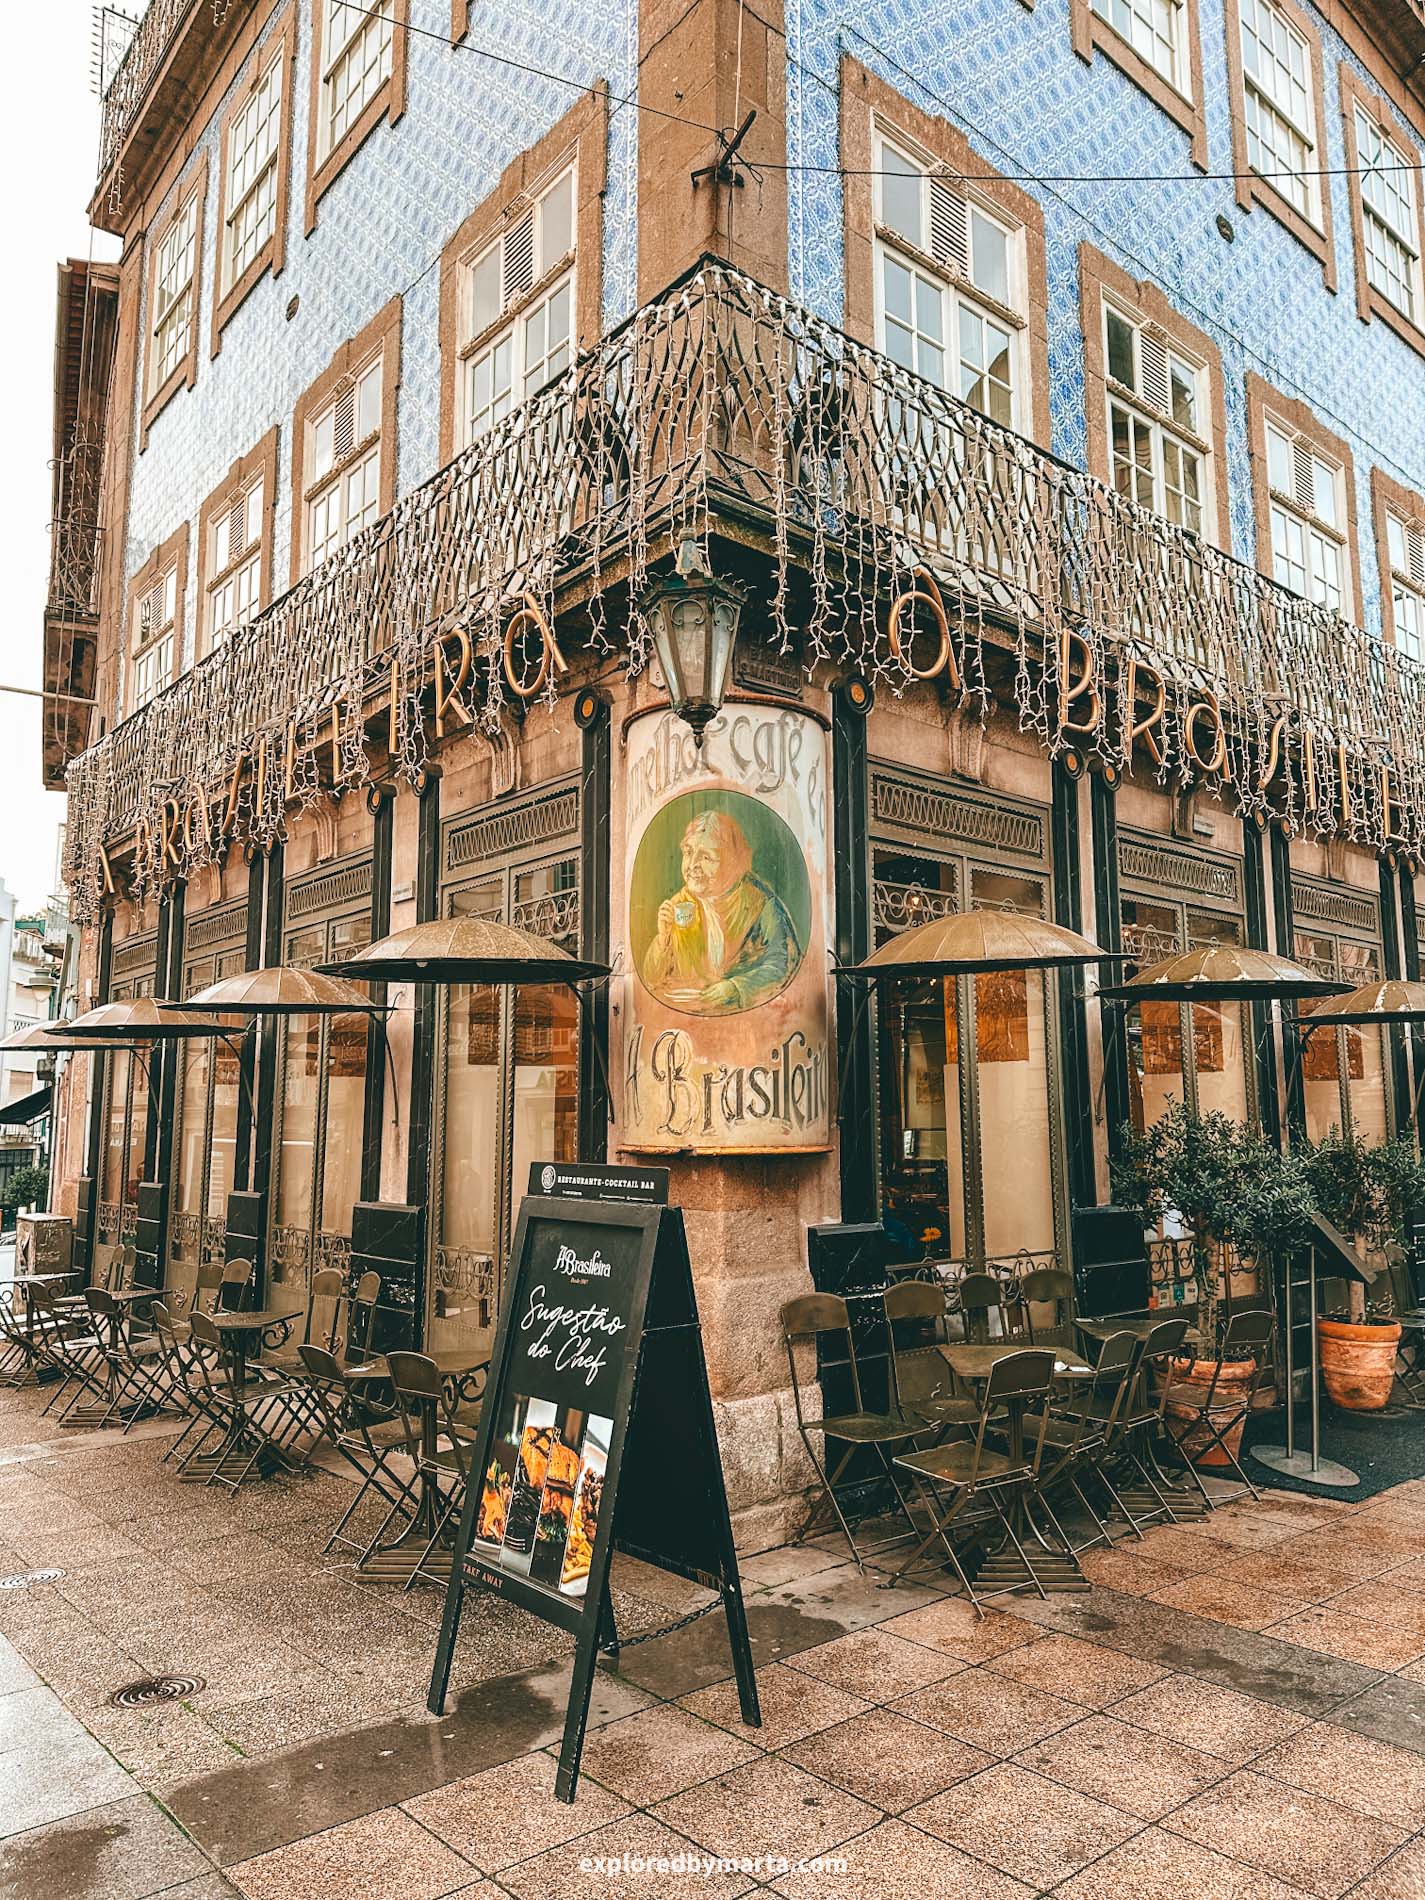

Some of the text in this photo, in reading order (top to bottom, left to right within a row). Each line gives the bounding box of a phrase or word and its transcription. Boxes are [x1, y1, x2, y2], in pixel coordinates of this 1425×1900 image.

[640, 1181, 655, 1190] BAR
[520, 1284, 626, 1337] Sugestão
[527, 1332, 606, 1386] do Chef
[463, 1563, 503, 1589] TAKE AWAY
